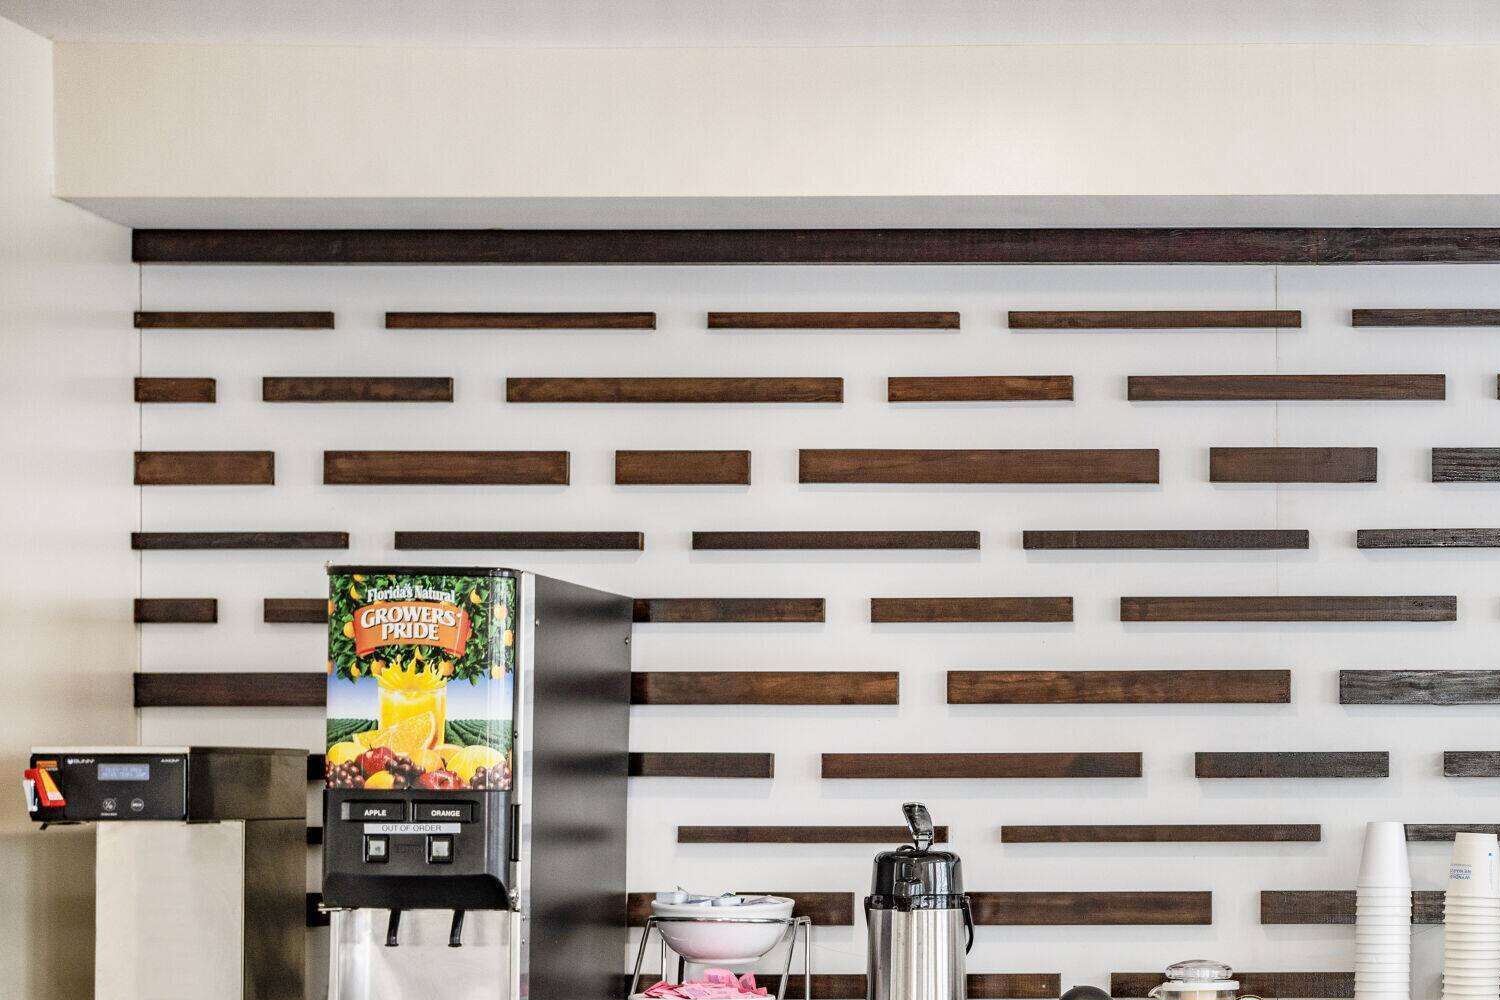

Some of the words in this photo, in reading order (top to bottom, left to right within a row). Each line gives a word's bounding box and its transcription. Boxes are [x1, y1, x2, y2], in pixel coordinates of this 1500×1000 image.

[414, 585, 456, 604] Natural
[381, 622, 440, 641] PRIDE
[364, 809, 387, 817] APPLE
[381, 824, 398, 832] OUT
[400, 824, 412, 832] OF
[412, 824, 442, 832] ORDER
